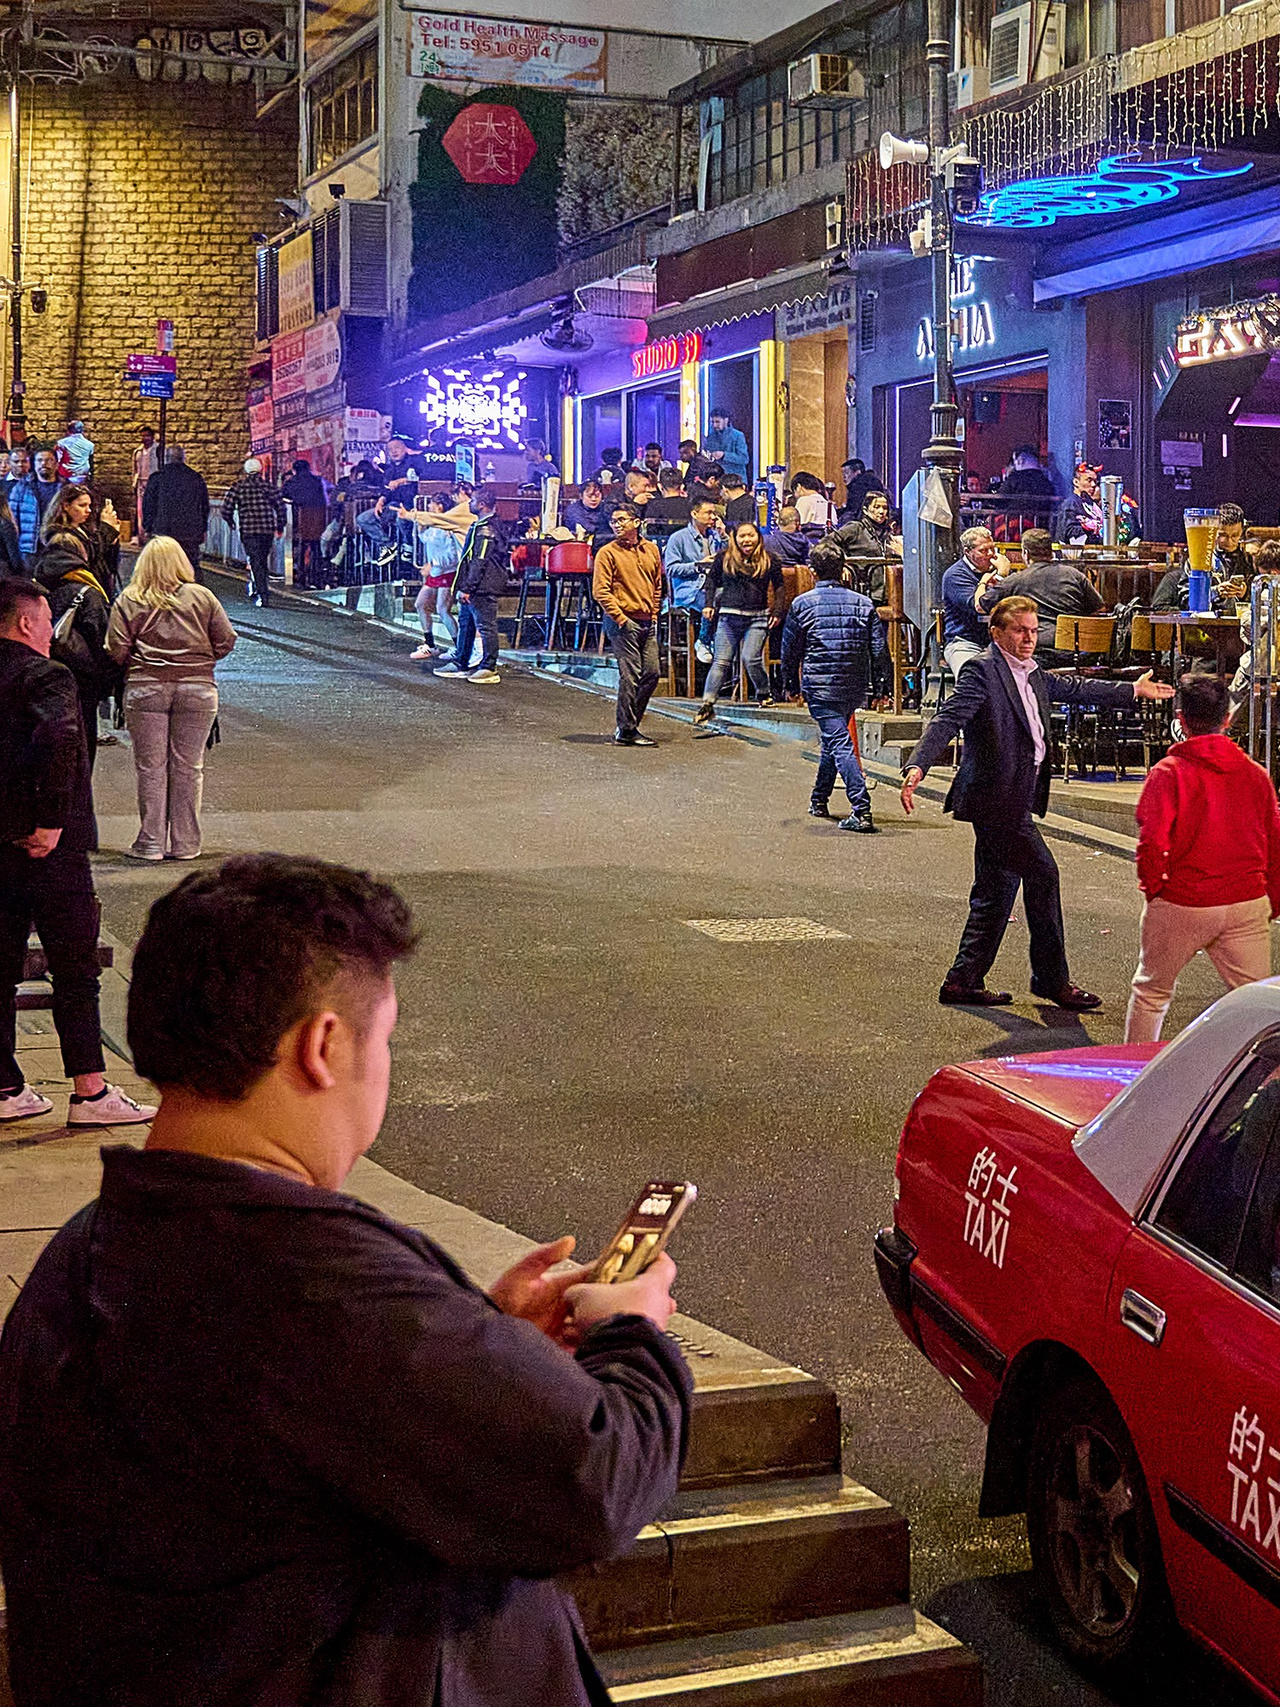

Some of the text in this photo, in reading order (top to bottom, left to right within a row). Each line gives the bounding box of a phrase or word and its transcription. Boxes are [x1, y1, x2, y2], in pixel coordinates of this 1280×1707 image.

[418, 15, 600, 48] Gold Health Massage
[421, 33, 552, 58] Tel: 5951 0514
[419, 50, 437, 62] 24
[631, 339, 678, 378] STUDIO
[967, 1146, 1018, 1217] 的士
[963, 1191, 1010, 1269] TAXI
